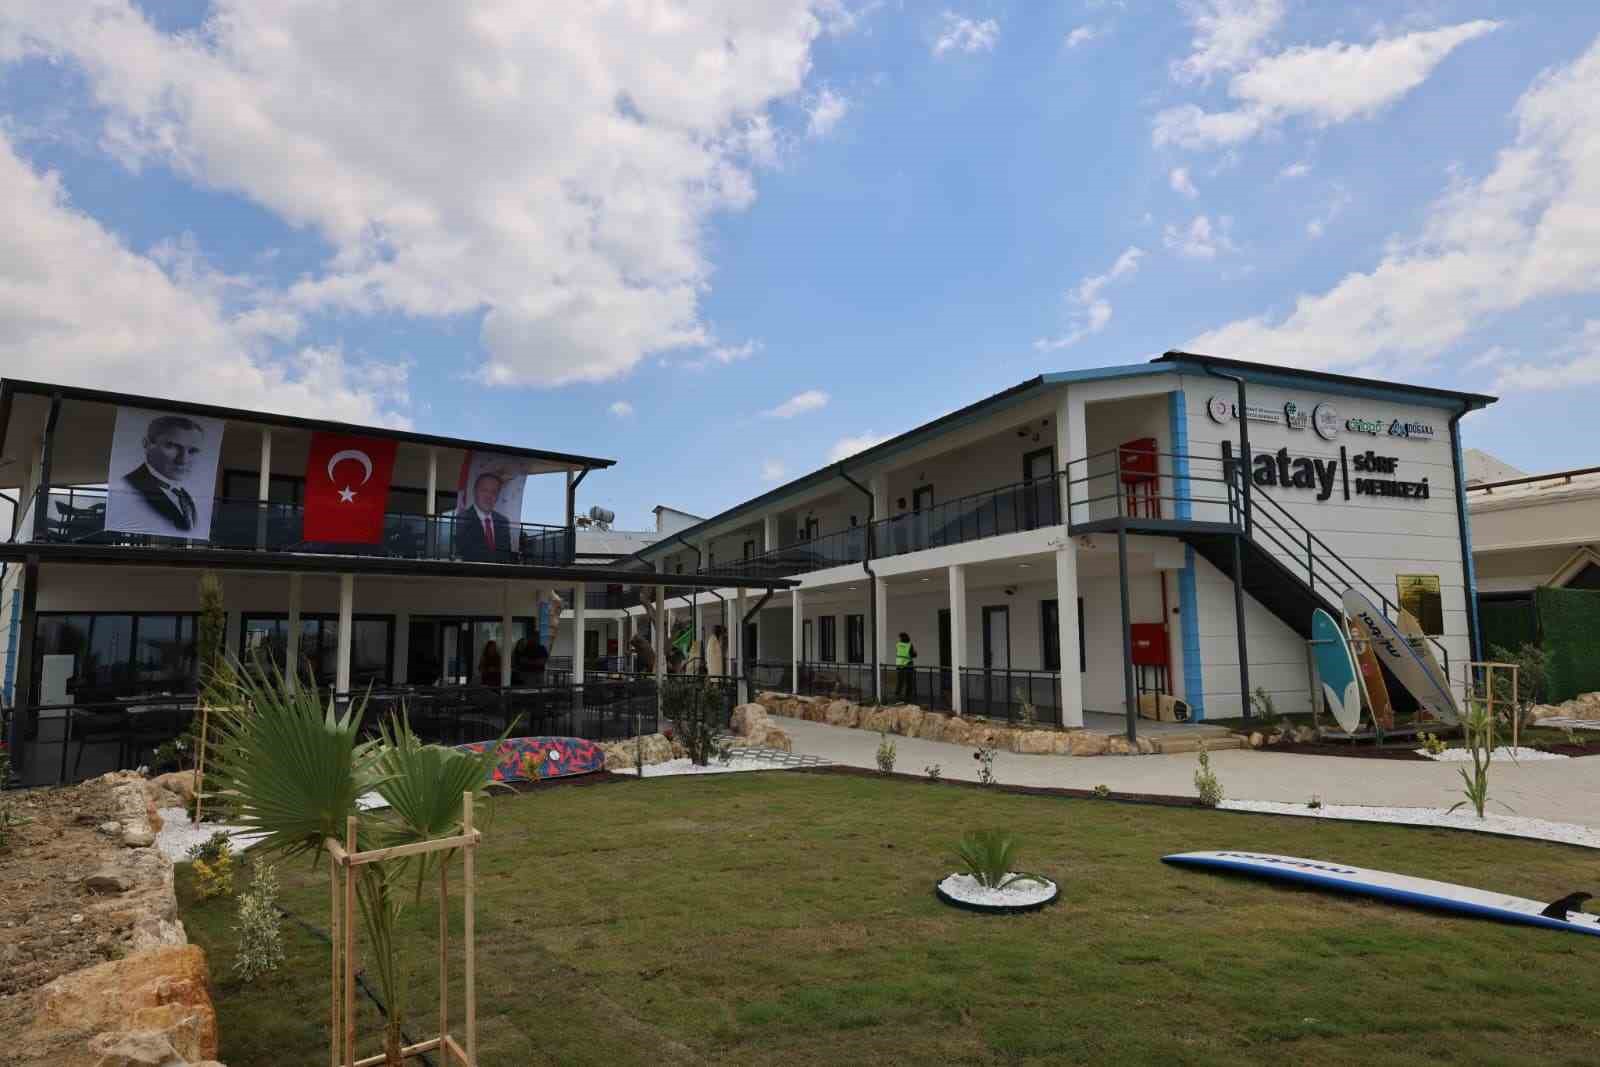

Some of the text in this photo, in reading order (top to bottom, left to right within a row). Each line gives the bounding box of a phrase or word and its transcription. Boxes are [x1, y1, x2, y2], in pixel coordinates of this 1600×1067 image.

[1222, 440, 1337, 501] Hatay
[1353, 450, 1399, 472] SÖRF
[1355, 477, 1429, 499] MERKEZİ
